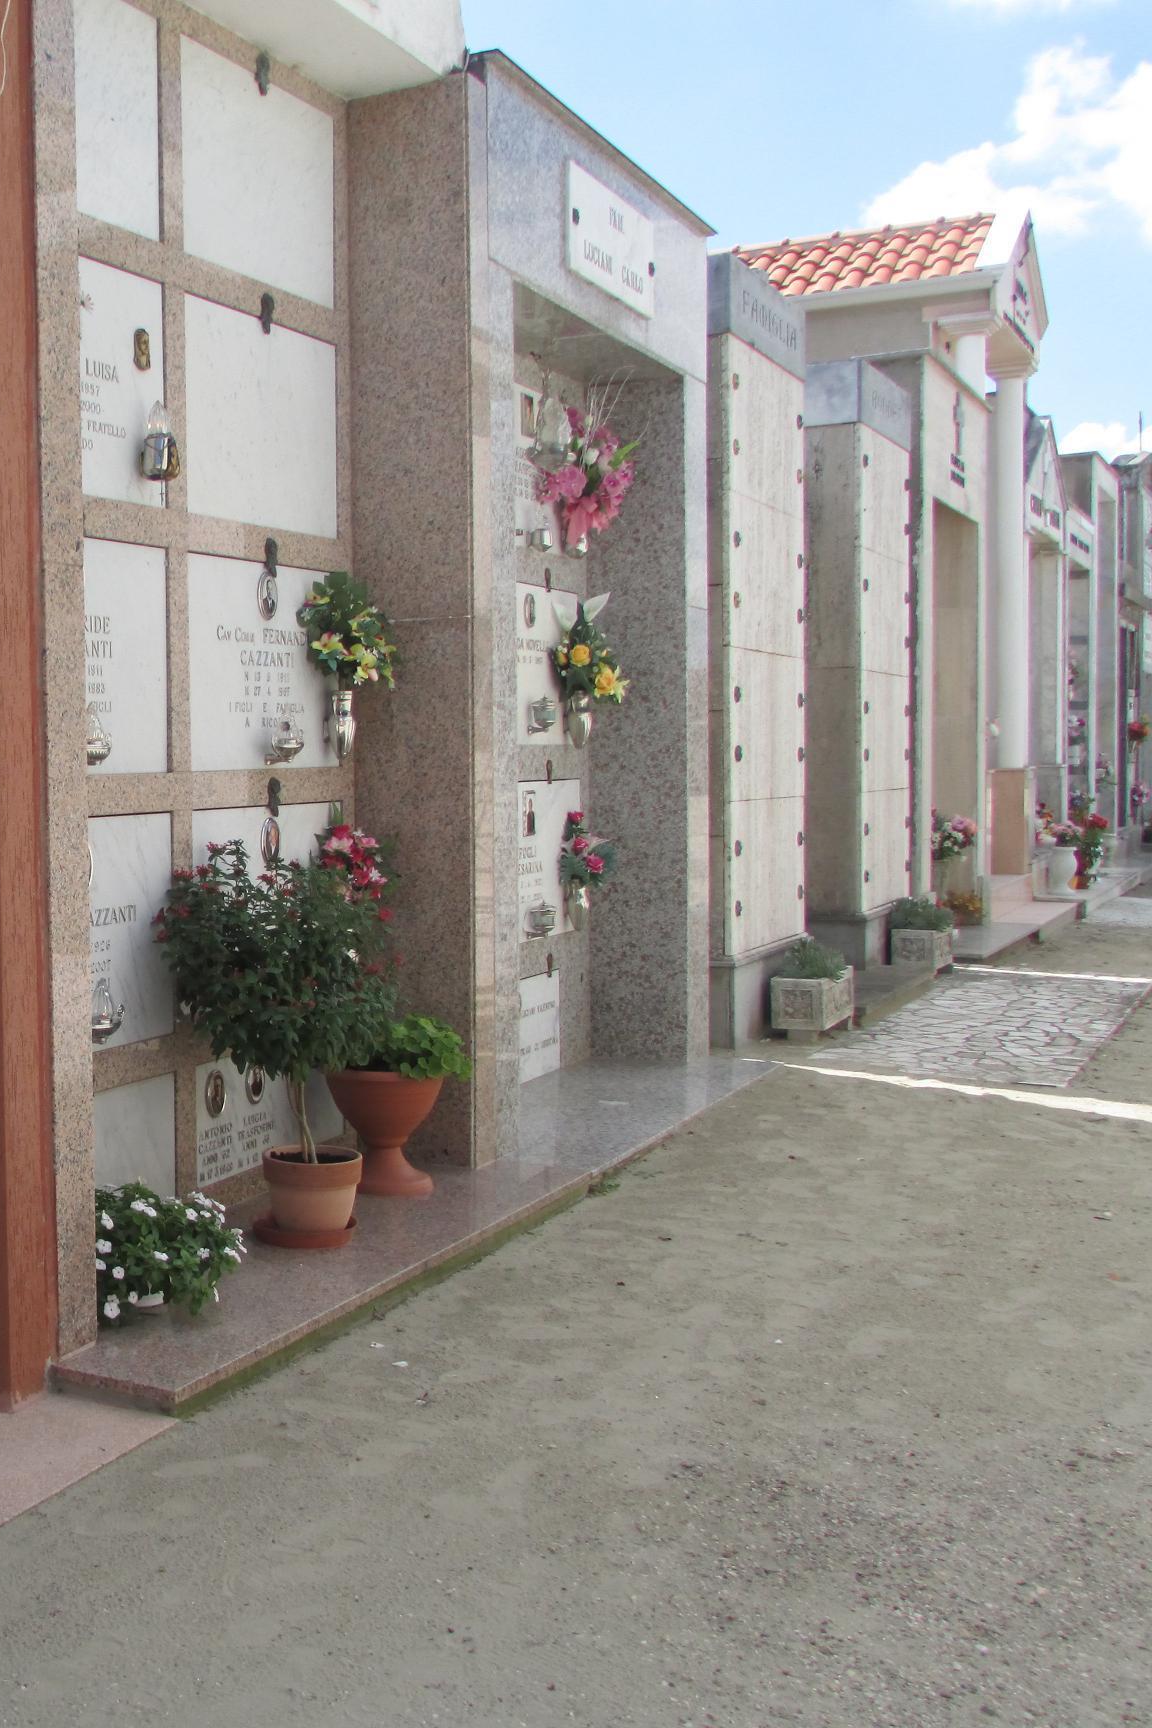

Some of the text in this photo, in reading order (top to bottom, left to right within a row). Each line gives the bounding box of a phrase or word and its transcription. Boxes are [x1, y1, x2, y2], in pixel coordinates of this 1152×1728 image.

[742, 289, 797, 351] FAMIGLIA
[85, 357, 119, 383] LUISA
[87, 420, 126, 439] FRATELLO
[263, 628, 307, 647] FERNAND
[240, 650, 295, 668] CAZZANTI
